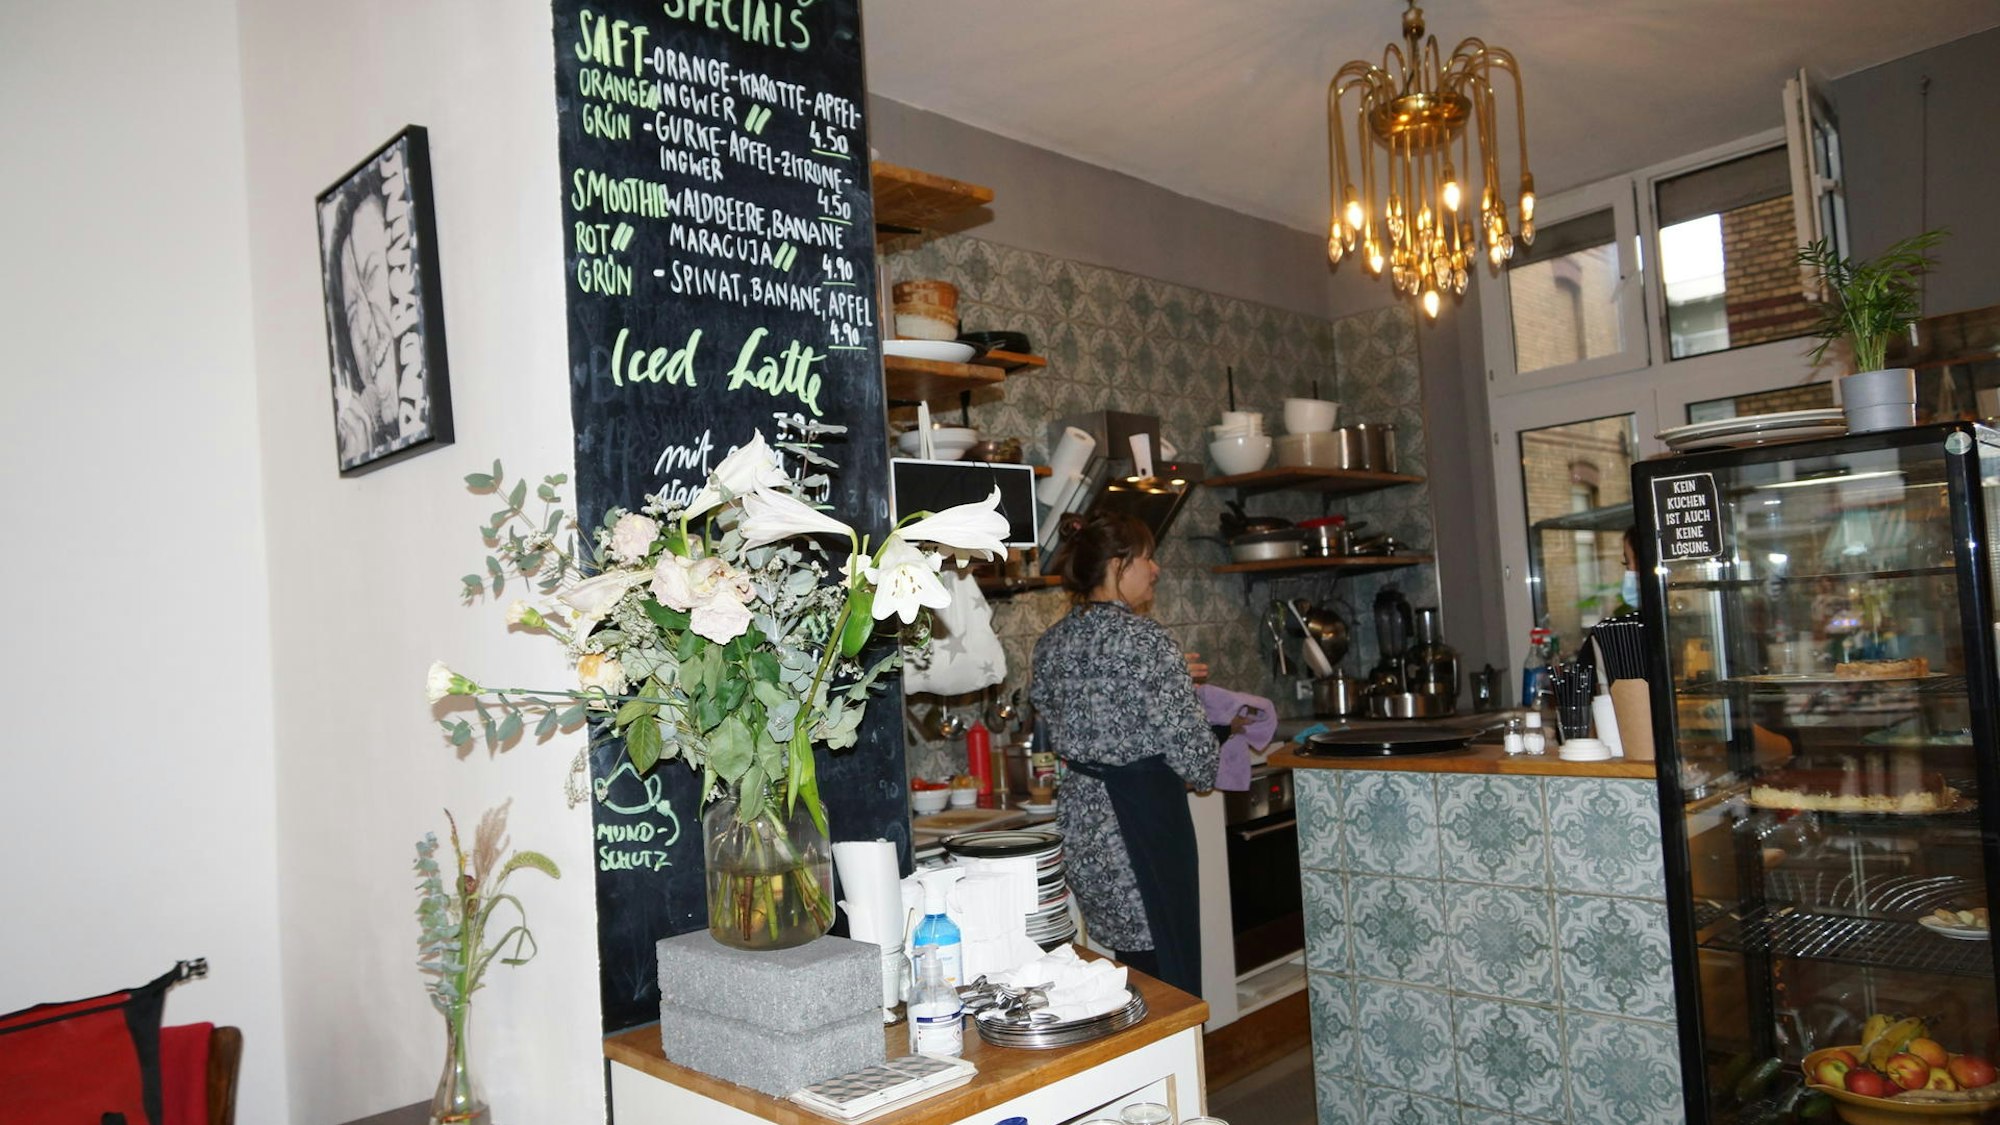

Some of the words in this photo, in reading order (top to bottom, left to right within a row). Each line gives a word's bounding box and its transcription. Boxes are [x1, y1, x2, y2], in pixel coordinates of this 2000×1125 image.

[575, 9, 649, 77] SAFT
[656, 79, 737, 125] INGWER
[809, 120, 849, 154] 4.50
[660, 146, 724, 183] INGWER
[817, 188, 851, 220] 4.50
[575, 221, 611, 255] ROT
[669, 222, 773, 265] MARACUJA
[822, 253, 854, 281] 4.90
[829, 290, 874, 327] APFEL
[830, 319, 860, 346] 4.90
[611, 327, 703, 387] Iced
[727, 326, 828, 417] Latte
[653, 429, 714, 477] mit
[1673, 480, 1696, 493] KEIN
[1666, 511, 1680, 525] IST
[1684, 509, 1711, 524] AUCH
[1667, 494, 1706, 510] KUCHEN
[1676, 526, 1704, 540] KEINE
[1671, 541, 1712, 556] LÖSUNG.
[597, 822, 668, 843] MUND-
[599, 846, 672, 872] SCHUTZ
